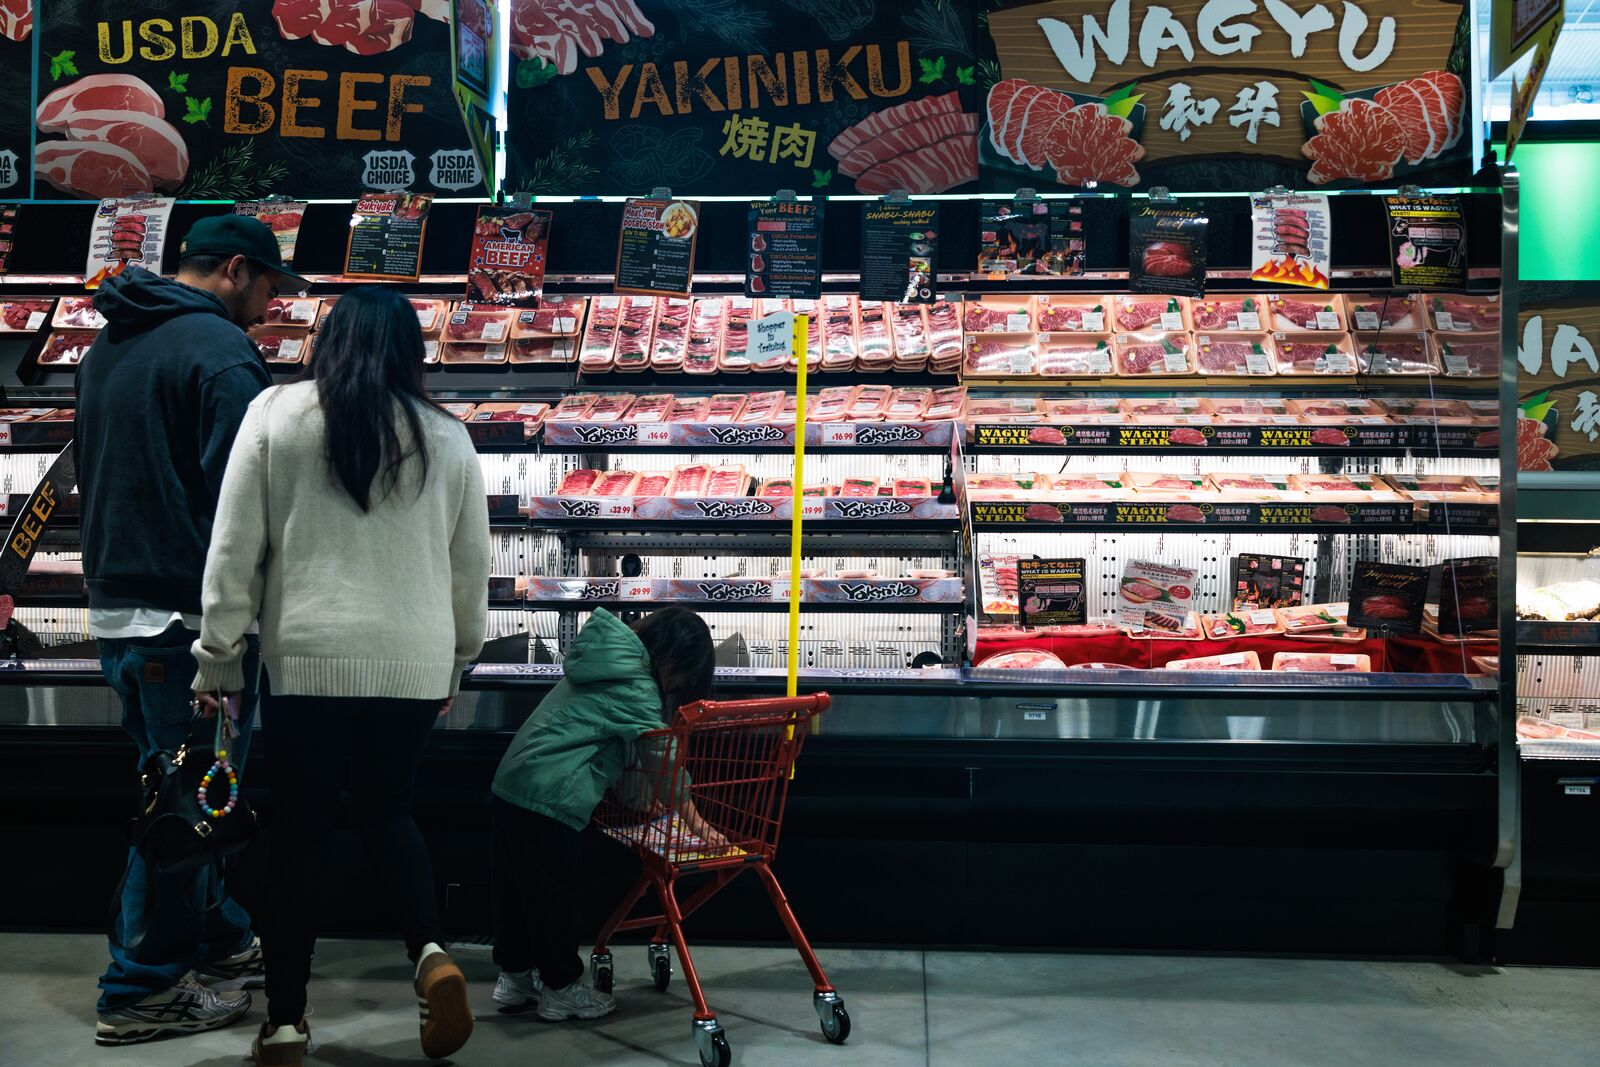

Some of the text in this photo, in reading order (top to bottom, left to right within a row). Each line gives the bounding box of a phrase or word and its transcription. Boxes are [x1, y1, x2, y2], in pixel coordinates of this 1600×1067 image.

[97, 12, 257, 64] USDA
[1037, 0, 1396, 84] WAGYU
[586, 41, 912, 120] YAKINIKU
[223, 66, 431, 142] BEEF
[1159, 81, 1281, 144] 和牛
[719, 113, 817, 169] 焼肉
[370, 156, 408, 170] USDA
[437, 155, 475, 169] USDA
[367, 170, 410, 184] CHOICE
[437, 170, 474, 183] PRIME
[357, 200, 396, 214] Sukiyaki
[1138, 207, 1198, 219] Japanese
[866, 210, 935, 220] SHABU-SHABU
[484, 241, 535, 253] AMERICAN
[485, 249, 530, 267] BEEF
[980, 429, 1029, 437] WAGYU
[1120, 430, 1169, 438] WAGYU
[1261, 430, 1311, 438] WAGYU
[979, 437, 1030, 445] STEAK
[975, 506, 1025, 514] WAGYU
[1116, 507, 1167, 515] WAGYU
[1260, 508, 1311, 516] WAGYU
[11, 481, 55, 559] BEEF
[975, 514, 1026, 522] STEAK
[1260, 516, 1312, 524] STEAK
